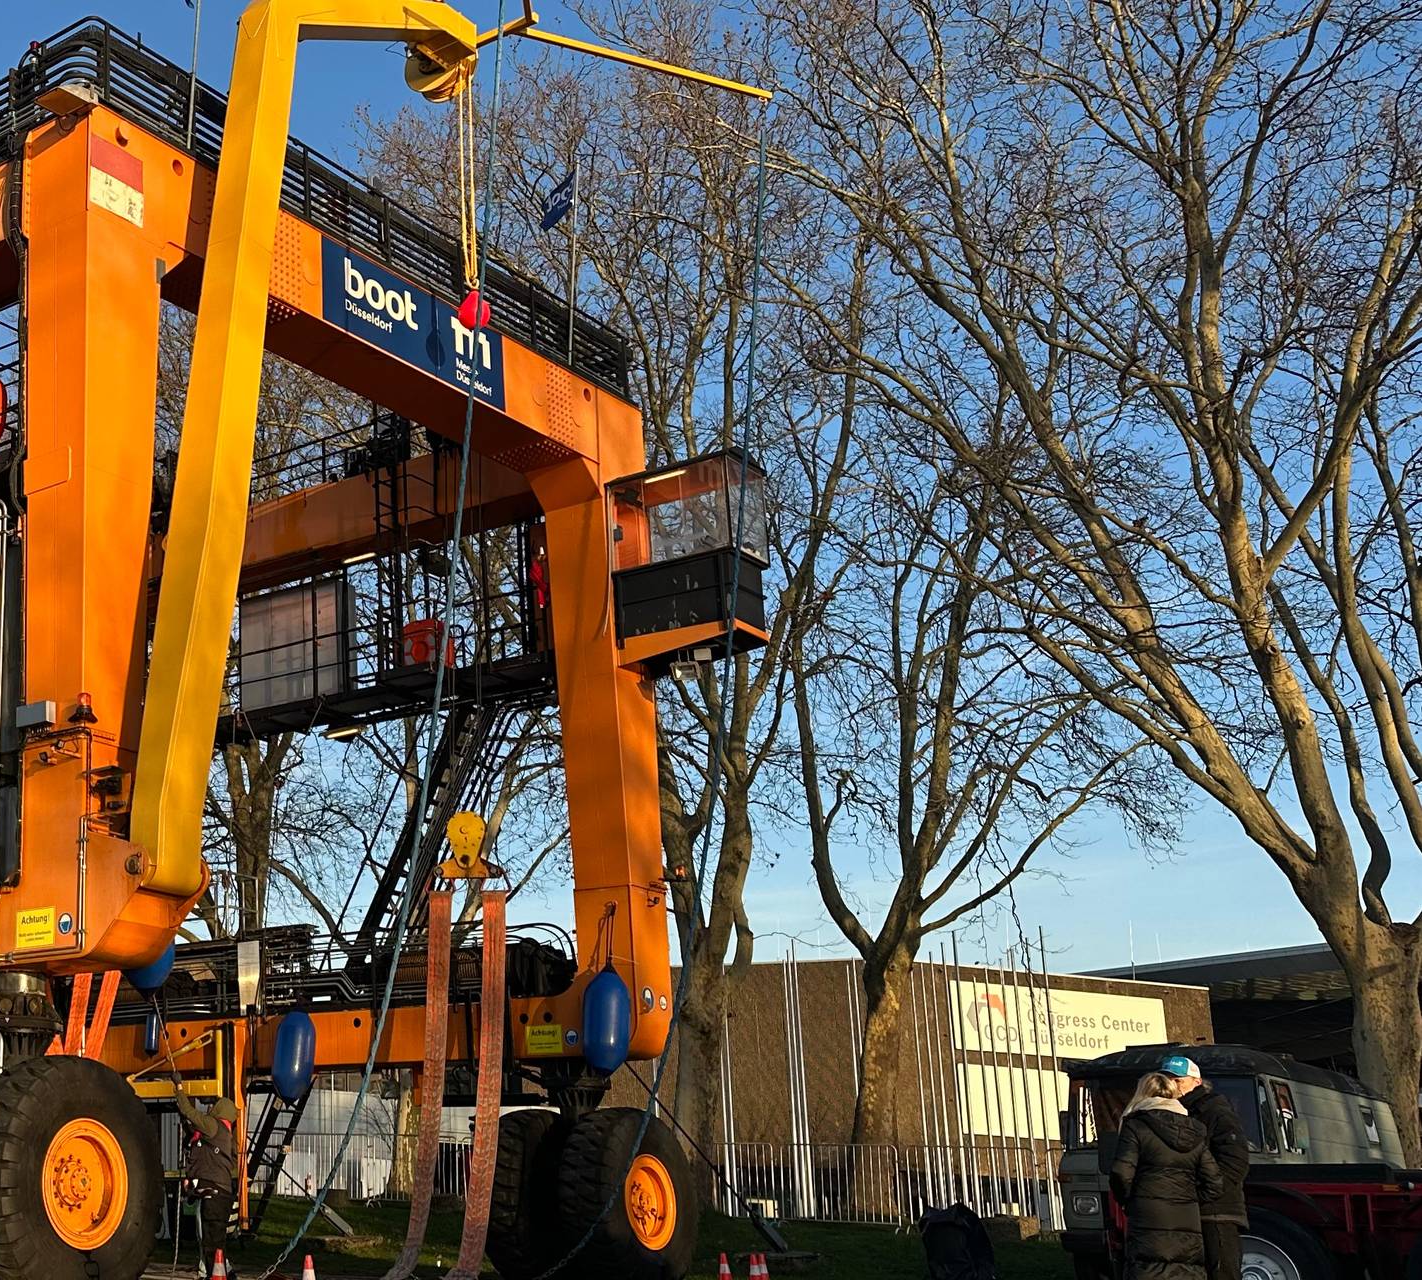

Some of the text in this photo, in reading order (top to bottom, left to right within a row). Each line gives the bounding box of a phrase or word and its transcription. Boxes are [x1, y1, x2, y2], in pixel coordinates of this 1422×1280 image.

[344, 257, 418, 331] boot
[345, 299, 393, 333] Düsseldorf
[456, 370, 492, 396] Düseldorf
[21, 913, 50, 925] Achtung!
[984, 1024, 1018, 1042] CCD
[1101, 1015, 1151, 1034] Center
[1029, 1029, 1109, 1050] Düseldorf
